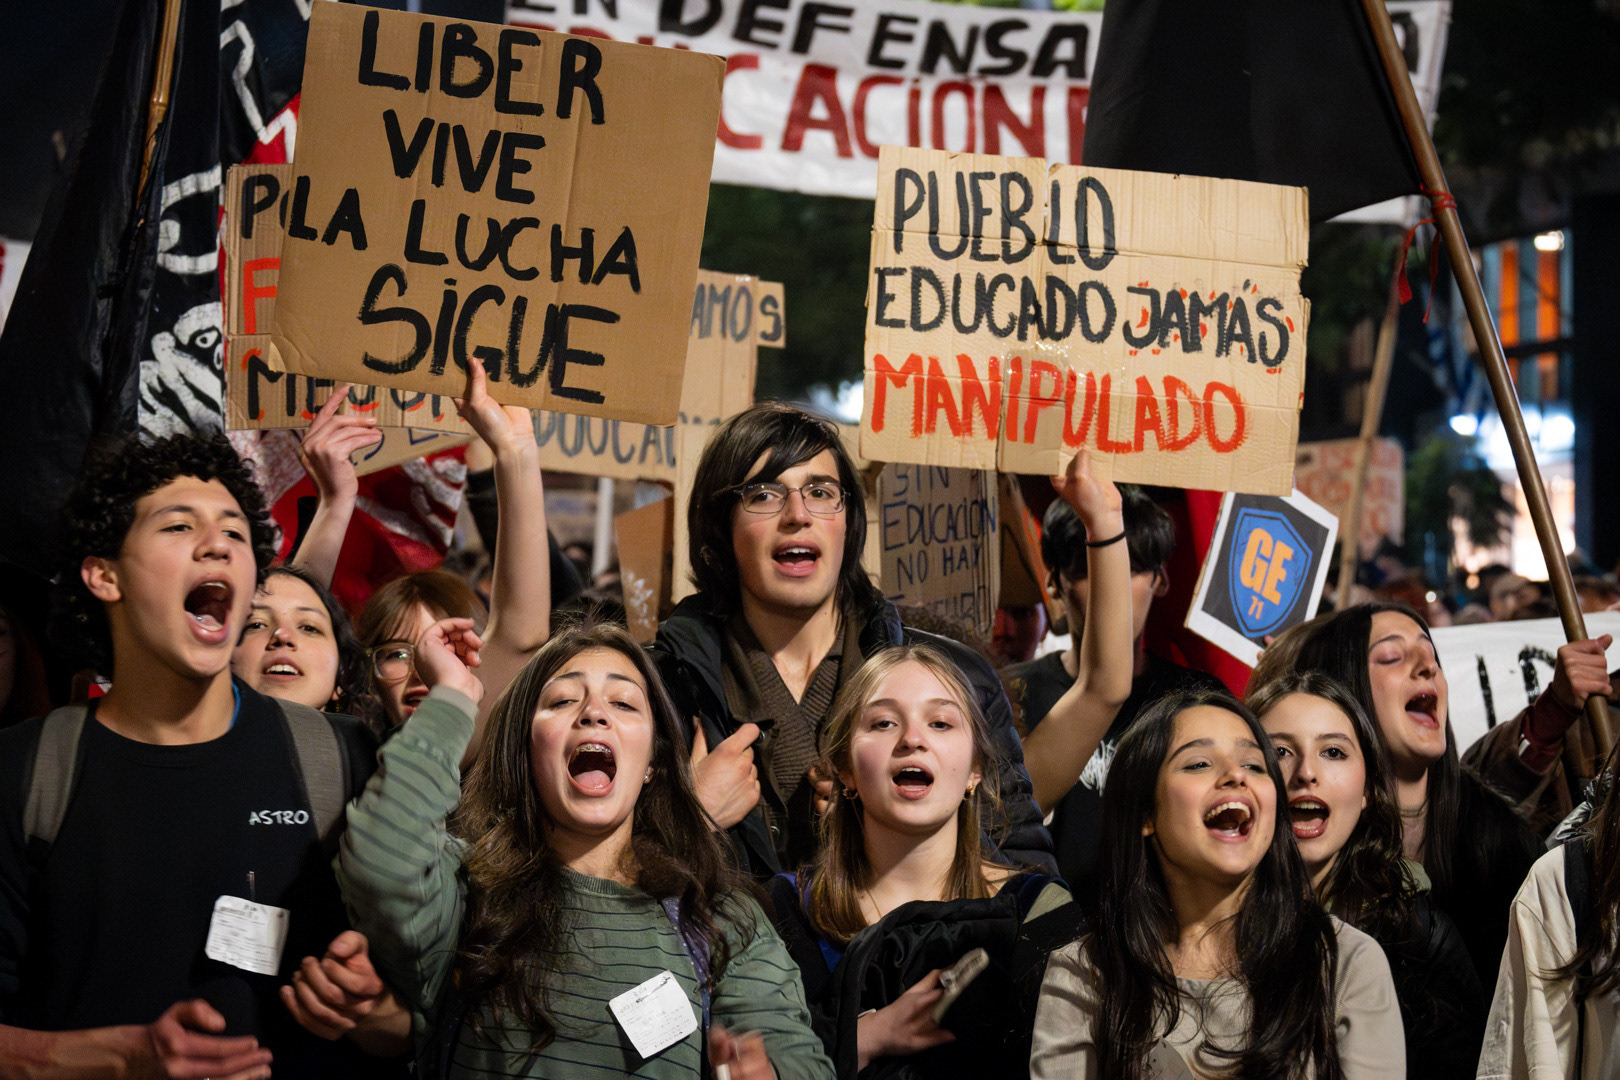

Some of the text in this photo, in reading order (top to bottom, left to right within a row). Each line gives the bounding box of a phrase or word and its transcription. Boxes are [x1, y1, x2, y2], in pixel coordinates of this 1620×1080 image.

[358, 10, 605, 125] LIBER
[658, 0, 1088, 79] DEFENSA
[382, 108, 546, 203] VIVE
[288, 175, 368, 251] LA
[404, 199, 641, 294] LUCHA
[894, 167, 1119, 271] PUEBLO
[874, 265, 1290, 368] EDUCADO JAMÁS
[871, 352, 1247, 454] MANIPULADO
[896, 542, 982, 592] NO HAY
[1240, 527, 1294, 606] GE
[248, 809, 310, 826] ASTRO
